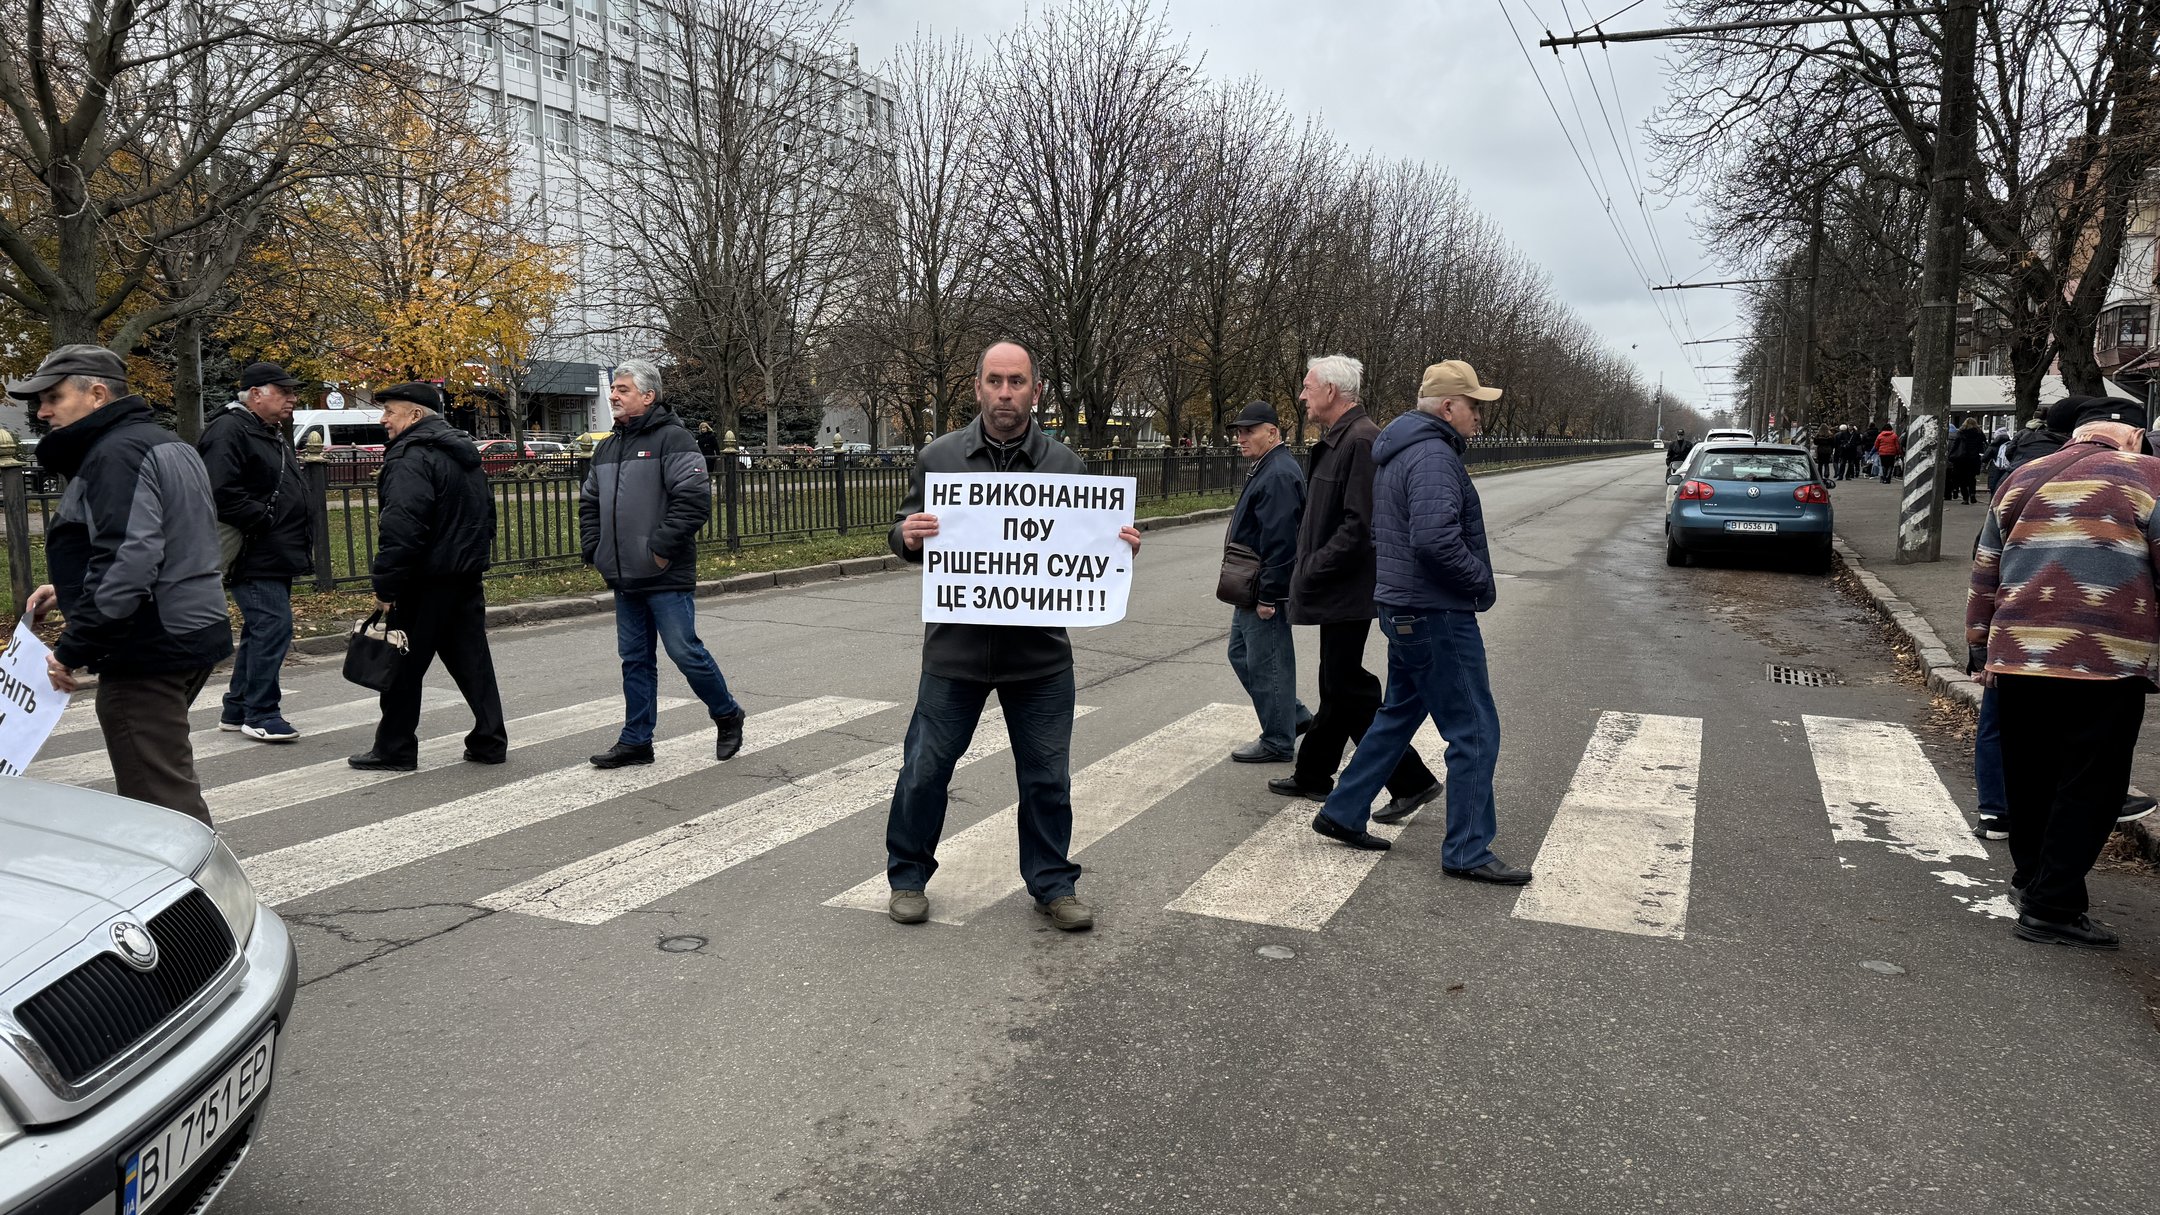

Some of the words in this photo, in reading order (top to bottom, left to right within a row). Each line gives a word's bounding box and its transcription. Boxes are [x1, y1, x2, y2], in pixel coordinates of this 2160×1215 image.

[932, 483, 962, 506] НЕ
[968, 483, 1125, 511] ВИКОНАННЯ
[1003, 517, 1055, 541] ПФУ
[928, 550, 1038, 575] РІШЕННЯ
[1047, 553, 1110, 582] СУДУ
[937, 585, 967, 612] ЦЕ
[972, 586, 1106, 612] ЗЛОЧИН!!!
[179, 1076, 231, 1168] 7151
[238, 1044, 267, 1109] EP
